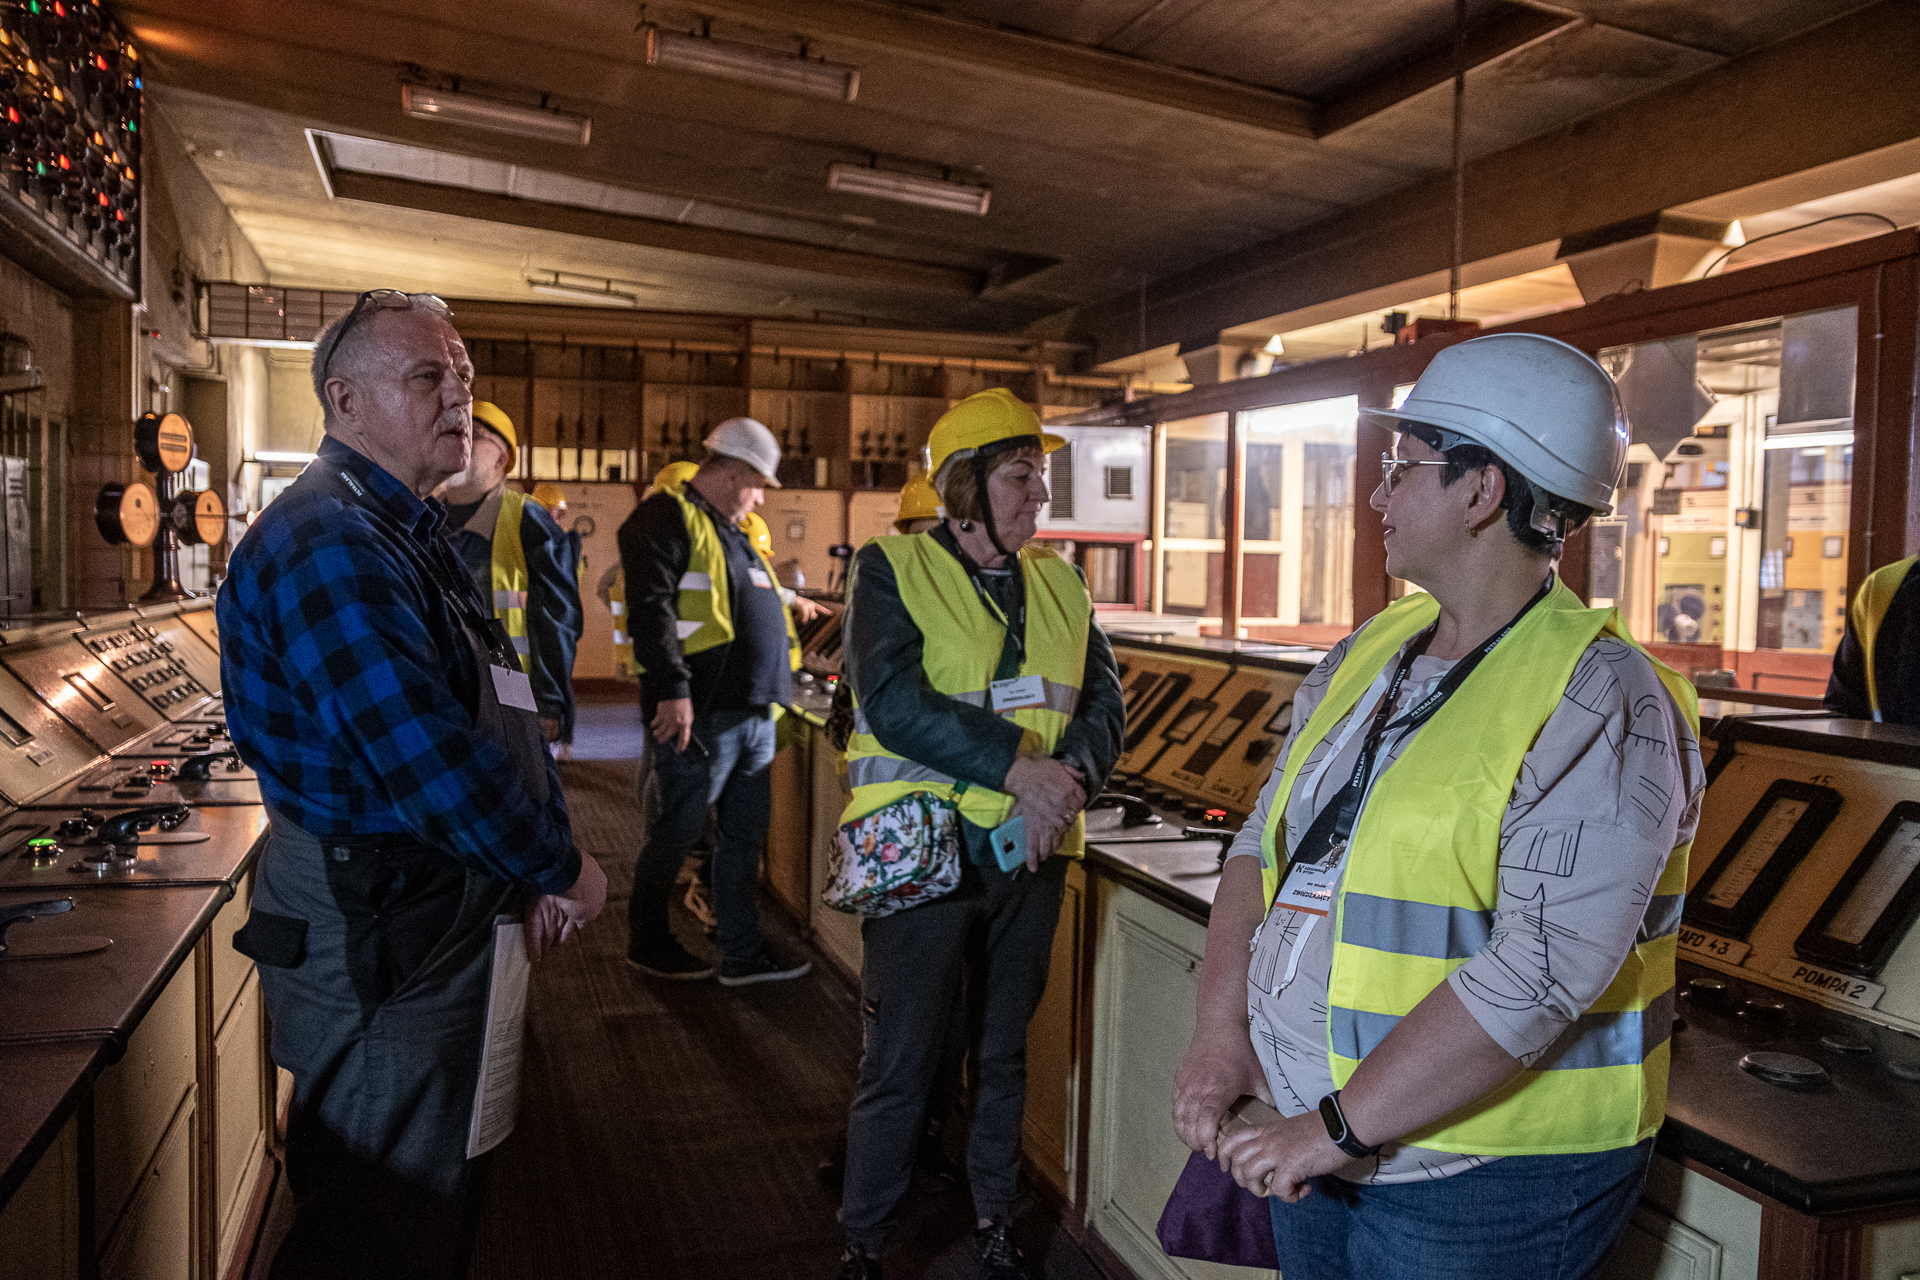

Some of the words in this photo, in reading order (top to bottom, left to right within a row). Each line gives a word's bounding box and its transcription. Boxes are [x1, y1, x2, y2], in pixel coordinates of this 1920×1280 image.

[1484, 627, 1512, 653] PETRALANA
[1389, 668, 1407, 700] PETRALANA
[1410, 690, 1444, 717] PETRALANA
[1352, 752, 1367, 787] PETRALANA
[1709, 939, 1731, 955] 43
[1792, 966, 1852, 994] POMPA
[1848, 984, 1868, 1000] 2
